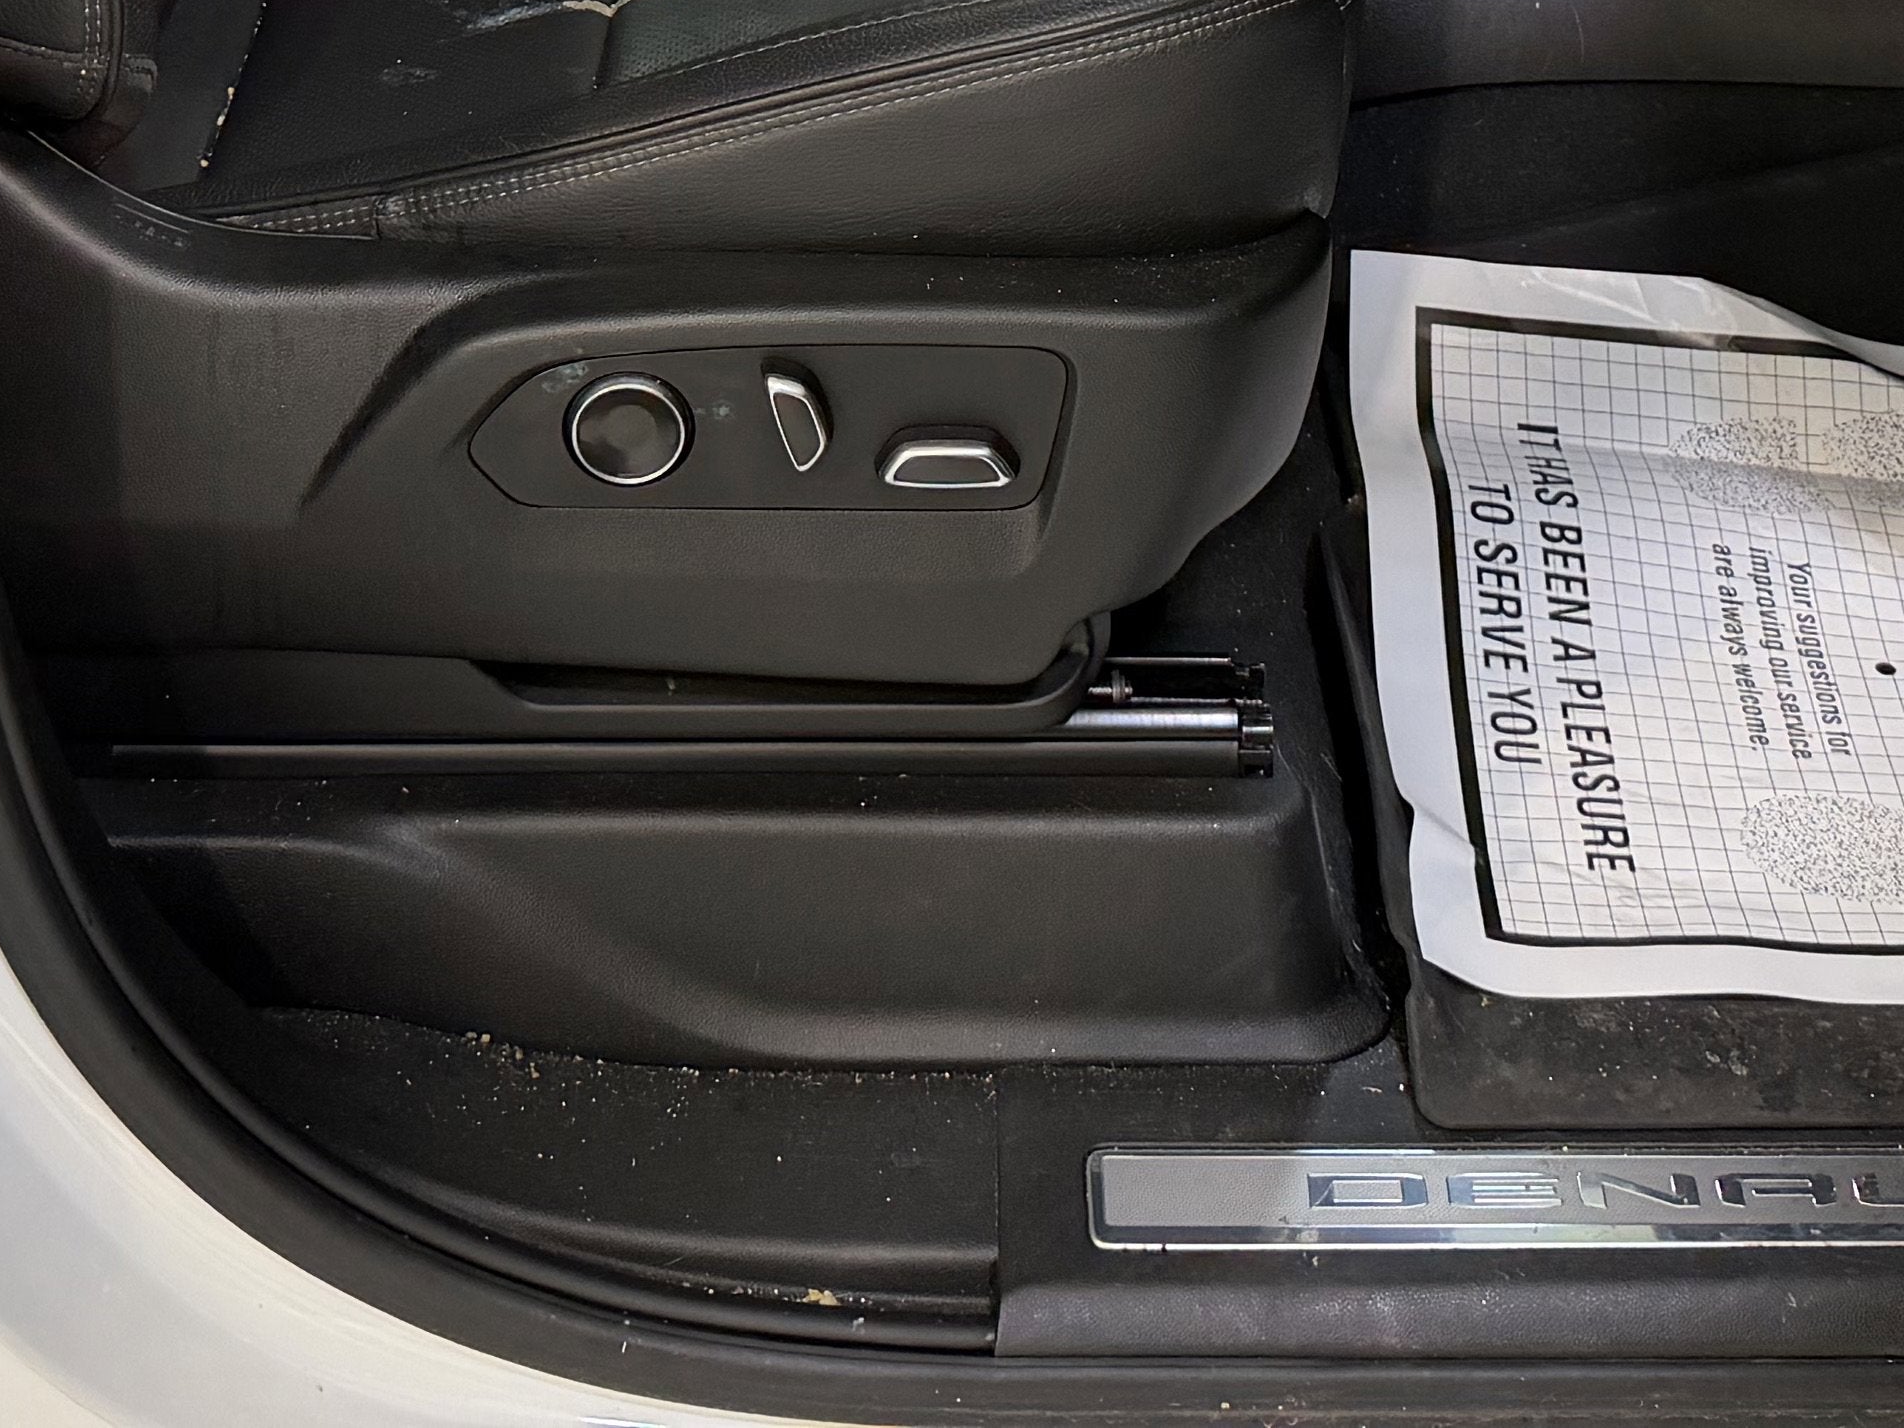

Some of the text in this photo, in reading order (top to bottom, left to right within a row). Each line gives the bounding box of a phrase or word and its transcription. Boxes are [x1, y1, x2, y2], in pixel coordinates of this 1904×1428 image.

[1467, 482, 1543, 765] TO SERVE YOU
[1516, 422, 1637, 874] IT HAS BEEN A PLEASURE
[1712, 543, 1771, 752] are always welcome.
[1748, 546, 1813, 761] improving our service
[1787, 562, 1852, 757] Your suggestions for
